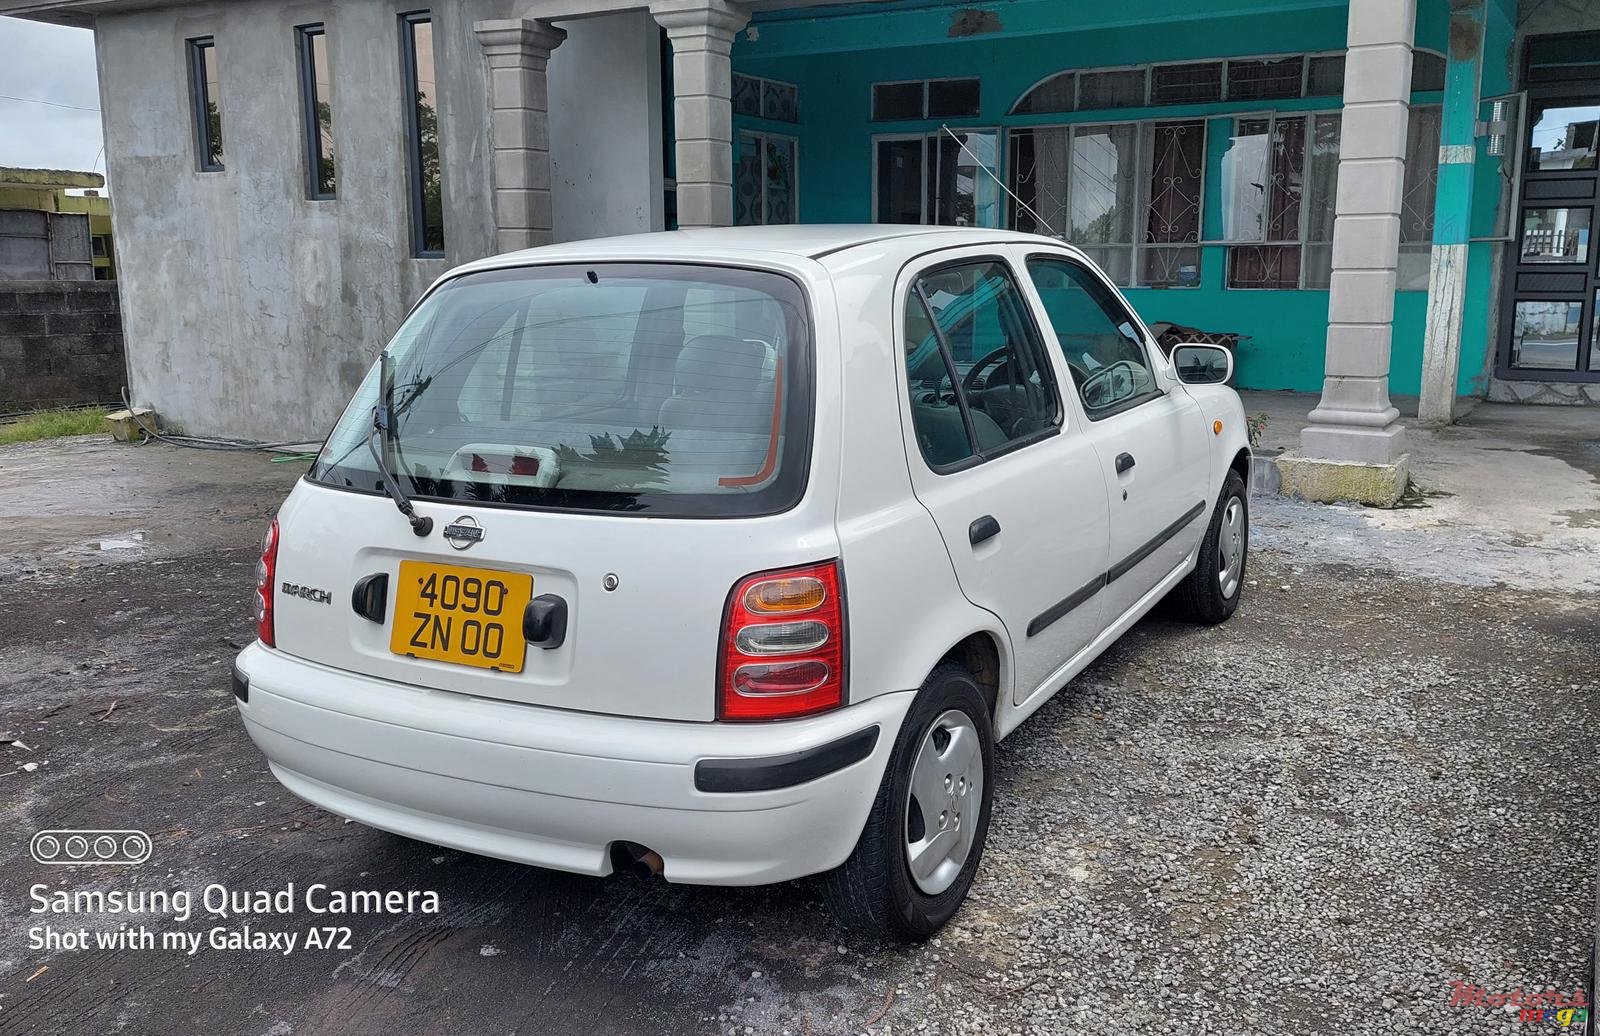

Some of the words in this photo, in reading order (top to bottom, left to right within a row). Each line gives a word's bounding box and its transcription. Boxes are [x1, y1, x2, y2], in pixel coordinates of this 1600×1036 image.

[420, 573, 504, 616] 4090
[410, 611, 453, 652] ZN
[460, 619, 504, 659] 00
